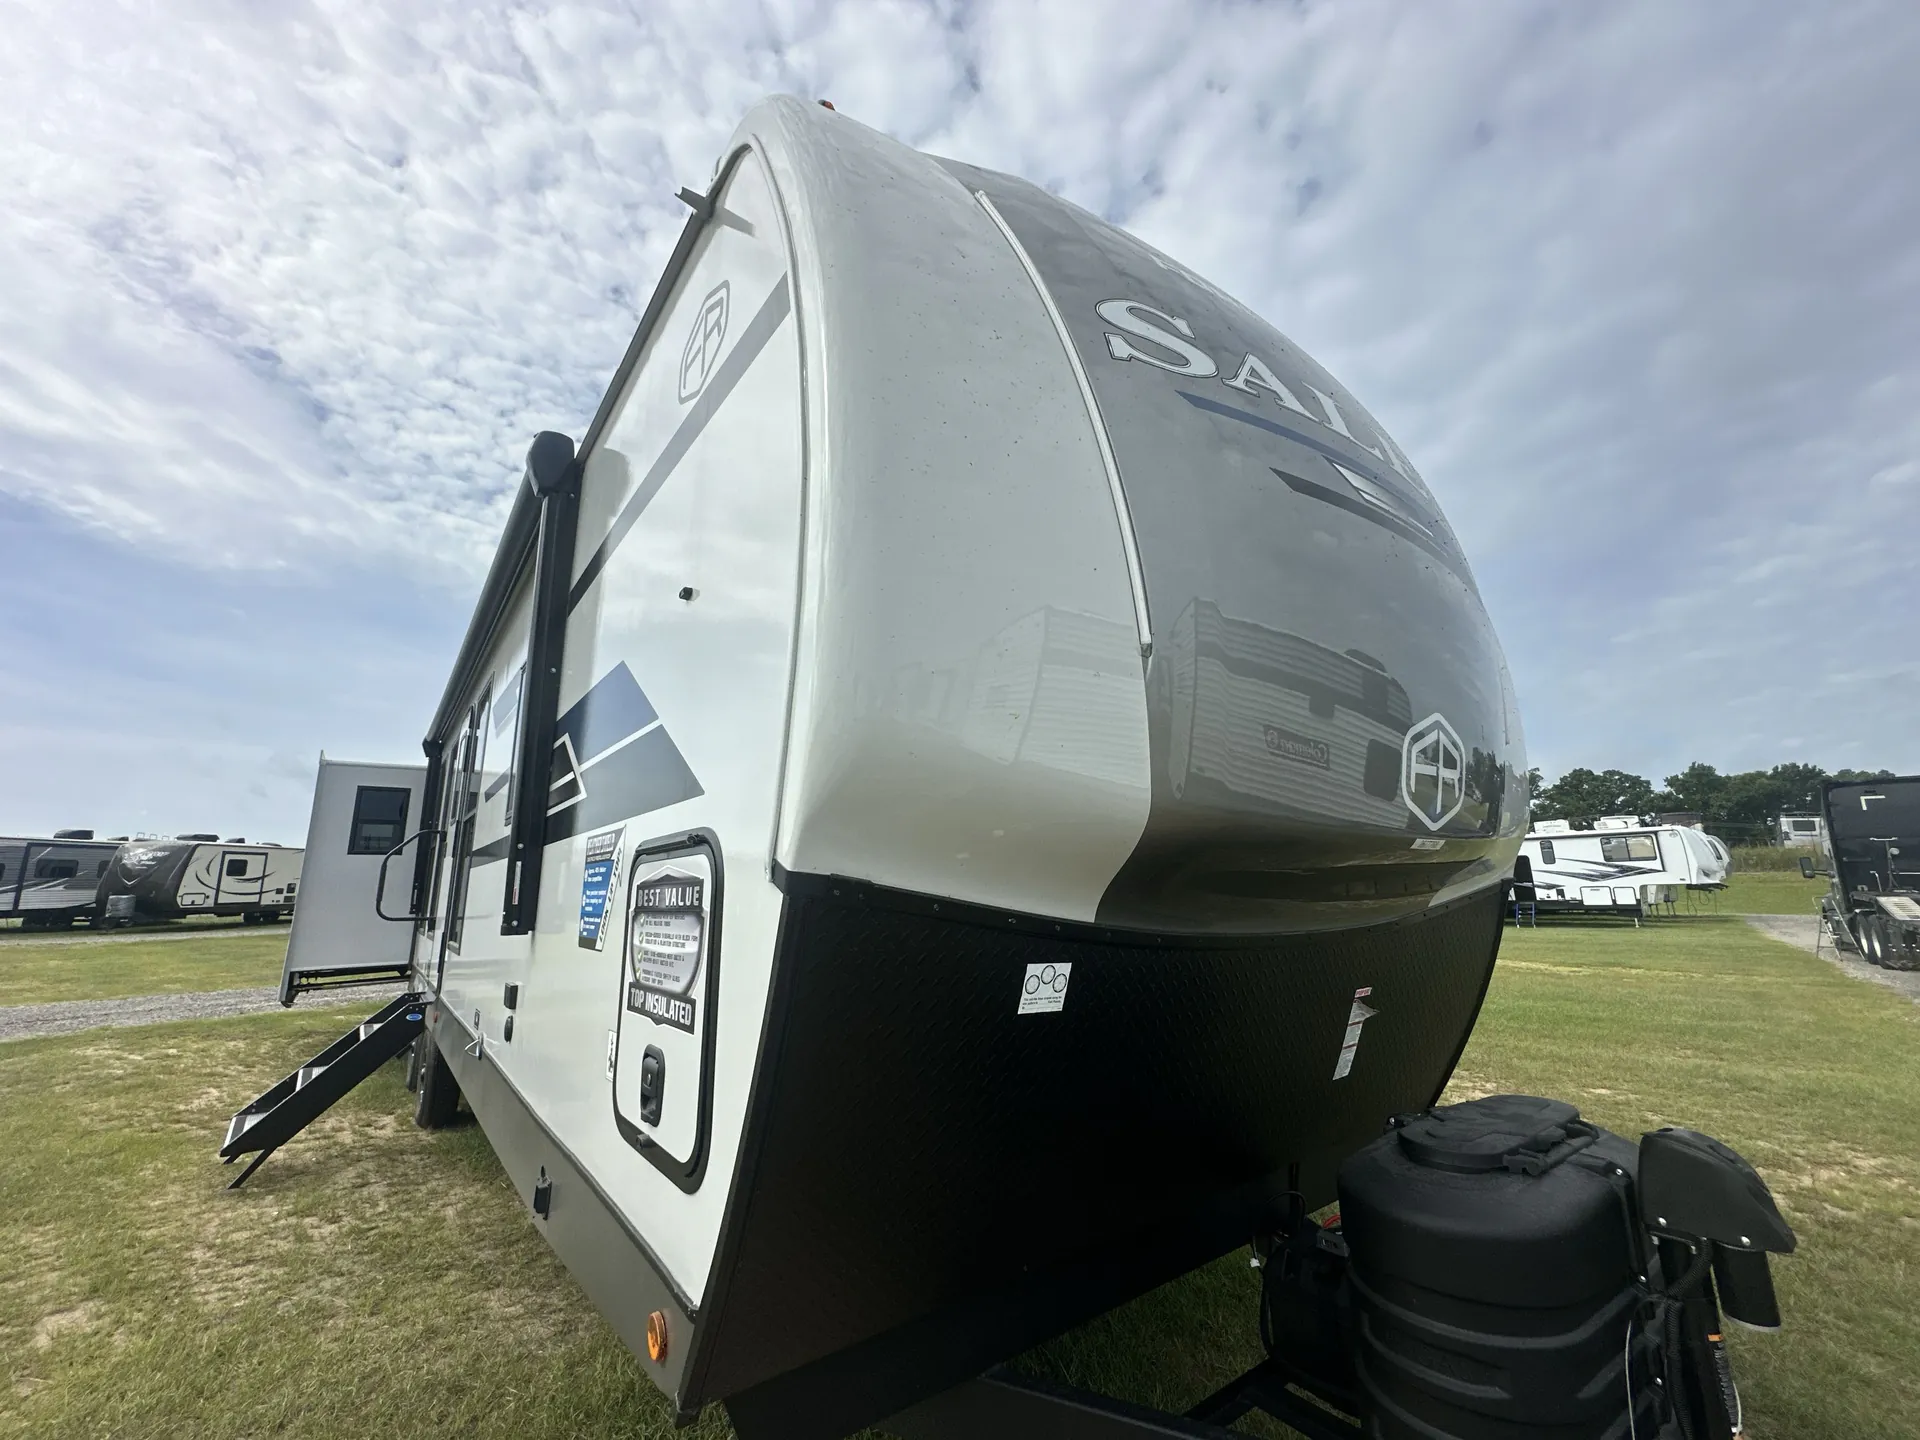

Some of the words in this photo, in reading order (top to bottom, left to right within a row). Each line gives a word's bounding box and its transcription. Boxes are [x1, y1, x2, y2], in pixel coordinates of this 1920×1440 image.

[637, 888, 661, 907] BEST
[665, 885, 700, 907] VALUE
[630, 987, 645, 1009] TOP
[645, 991, 692, 1026] INSULATED
